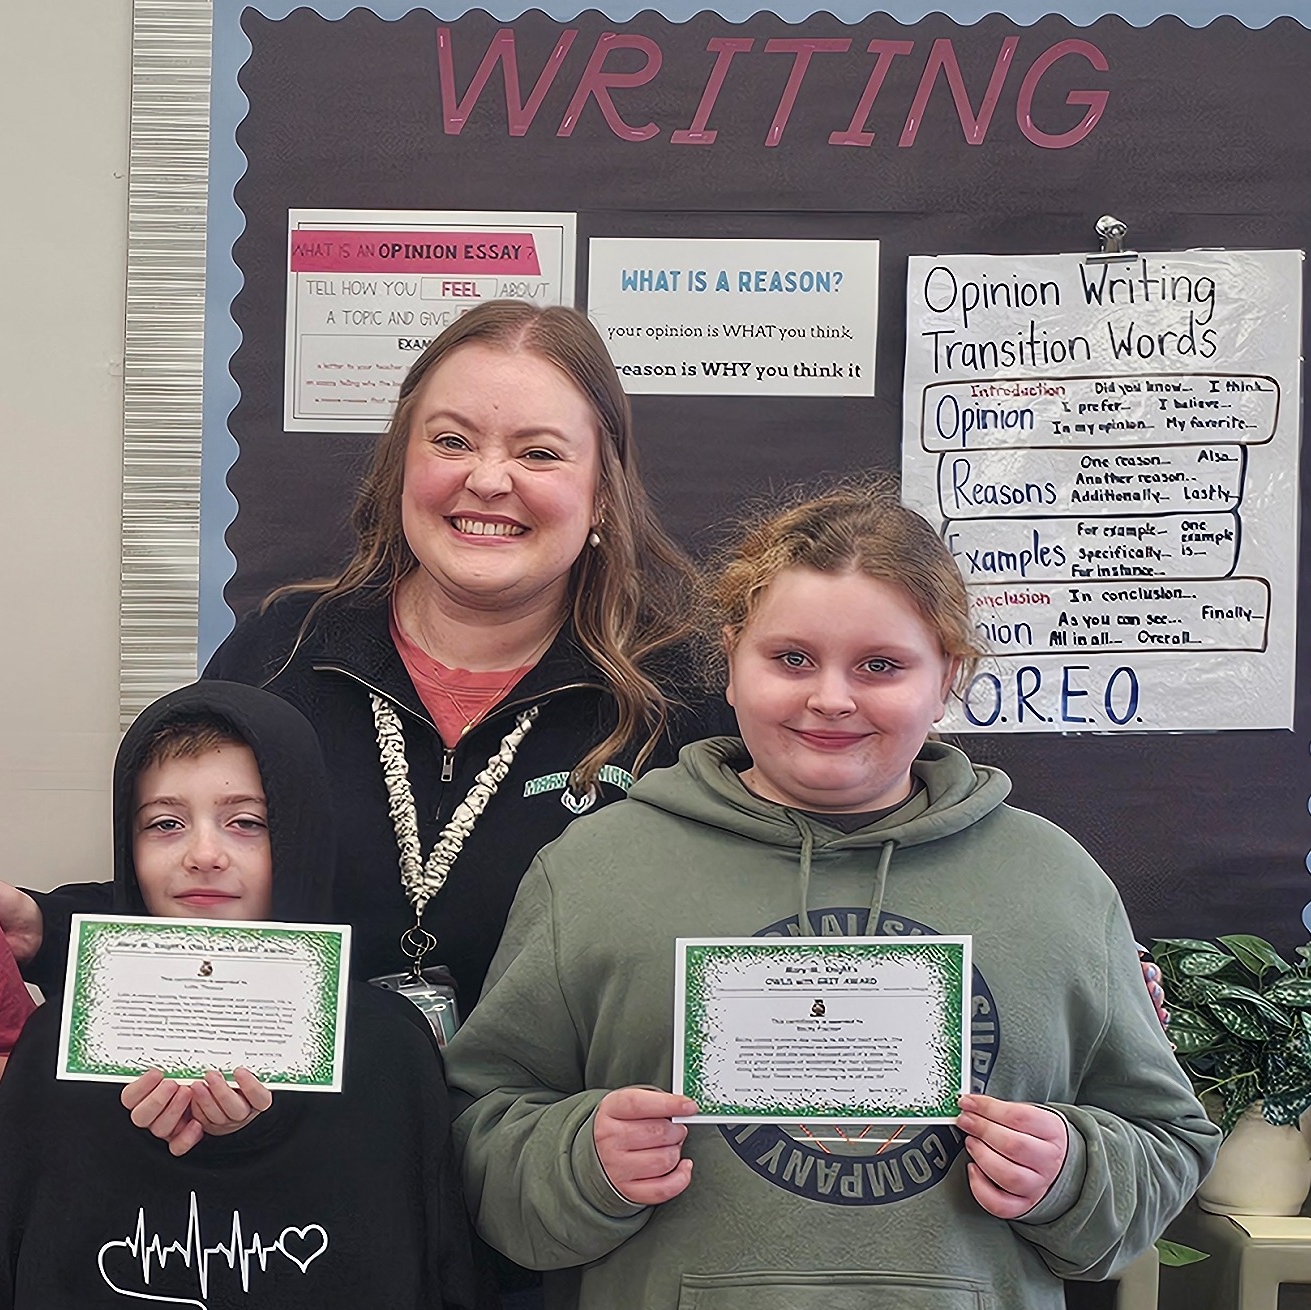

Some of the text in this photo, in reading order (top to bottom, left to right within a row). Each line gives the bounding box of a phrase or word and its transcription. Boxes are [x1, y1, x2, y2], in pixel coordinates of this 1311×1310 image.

[436, 27, 1110, 150] WRITING
[292, 243, 333, 257] WHAT
[339, 243, 351, 258] IS
[357, 244, 375, 257] AN
[378, 243, 458, 259] OPINION
[306, 280, 550, 298] TELL HOW YOU FEEL ABOUT
[621, 269, 844, 293] WHAT IS A REASON?
[924, 258, 1217, 328] Opinion Writing
[326, 310, 336, 325] A
[342, 310, 382, 326] TOPIC
[388, 311, 415, 326] AND
[419, 311, 451, 327] GIVE
[607, 325, 642, 340] your
[645, 324, 703, 340] opinion
[707, 324, 719, 338] is
[723, 325, 777, 338] WHAT
[778, 327, 806, 341] you
[922, 311, 1218, 374] Transition Words
[681, 361, 697, 377] is
[701, 362, 751, 377] WHY
[756, 366, 789, 381] you
[793, 363, 843, 378] think
[848, 364, 862, 378] it
[970, 384, 1066, 398] Introduction
[1095, 382, 1116, 394] Did
[1118, 383, 1142, 396] you
[1209, 380, 1220, 393] I
[936, 394, 1035, 448] Opinion
[1052, 421, 1071, 434] In
[1166, 416, 1186, 431] My
[1080, 455, 1110, 469] One
[952, 458, 1057, 509] Reasons
[1075, 472, 1134, 485] Another
[1077, 522, 1099, 536] For
[949, 529, 1067, 578] Examples
[970, 588, 1051, 608] onclusion
[1069, 589, 1092, 603] In
[1058, 611, 1079, 627] As
[1082, 614, 1110, 629] you
[756, 1132, 947, 1198] COMPANY
